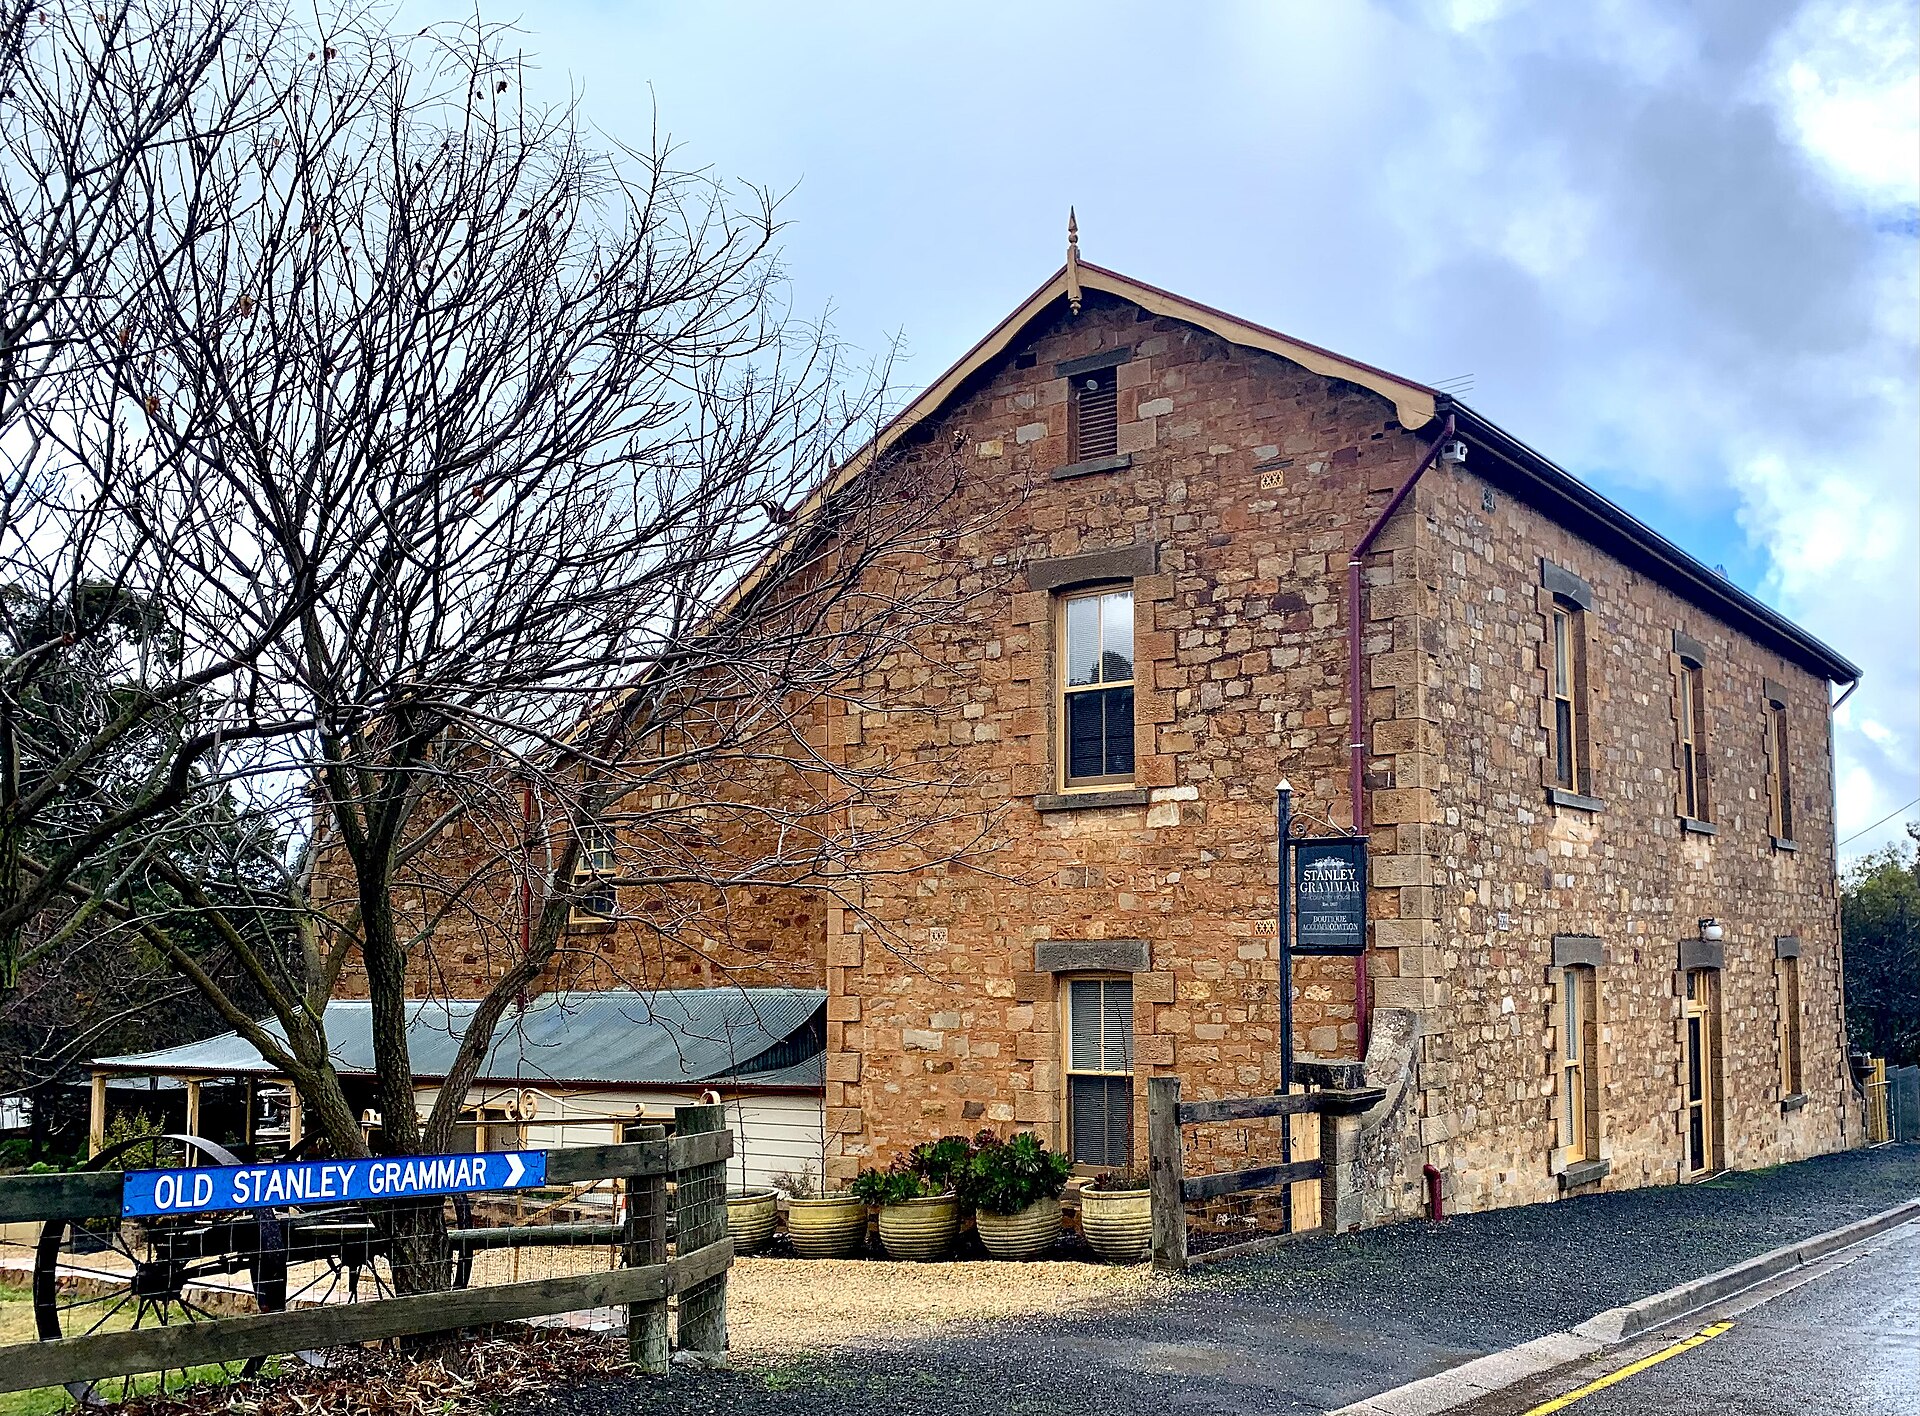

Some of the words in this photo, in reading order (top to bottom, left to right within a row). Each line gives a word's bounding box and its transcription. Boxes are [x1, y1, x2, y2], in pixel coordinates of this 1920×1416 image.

[1303, 869, 1355, 880] STANLEY
[1300, 881, 1360, 892] GRAMMAR
[155, 1174, 213, 1208] OLD
[232, 1165, 357, 1203] STANLEY
[368, 1157, 487, 1192] GRAMMAR
